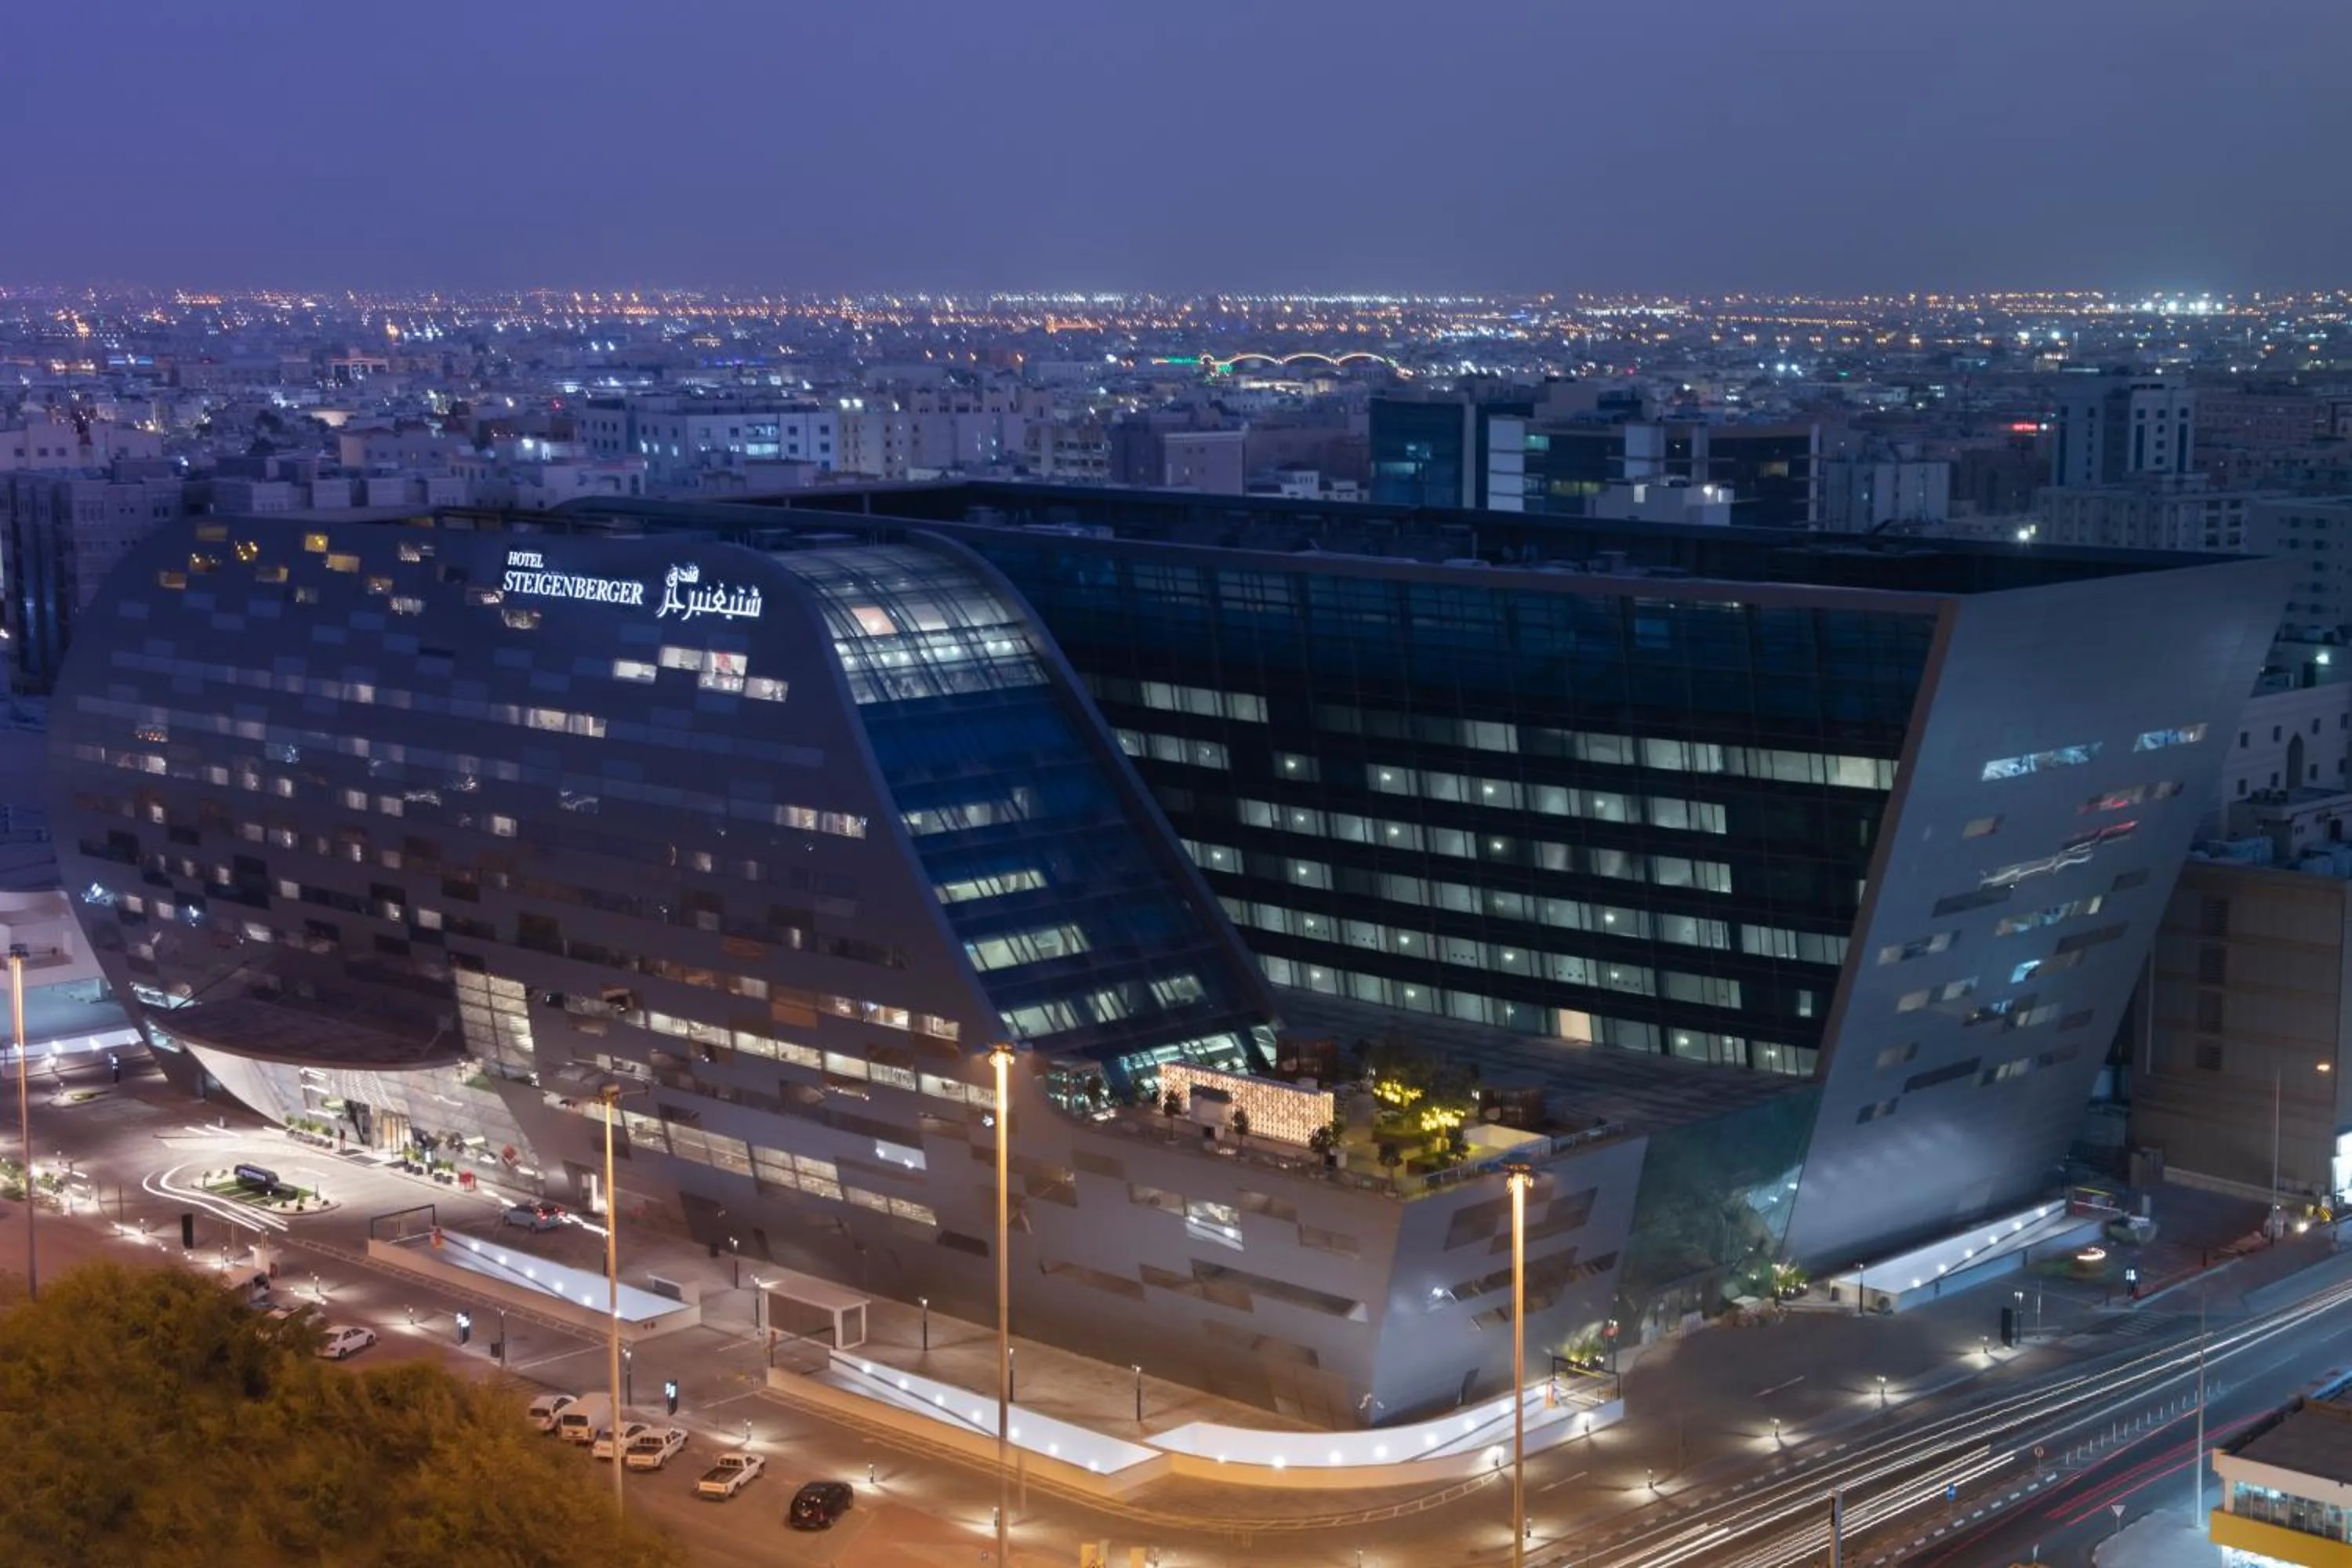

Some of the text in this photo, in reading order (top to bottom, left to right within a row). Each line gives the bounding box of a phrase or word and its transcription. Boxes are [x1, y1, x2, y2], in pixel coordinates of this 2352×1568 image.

[507, 550, 544, 568] HOTEL
[503, 570, 644, 605] STEIGENBERGER
[666, 563, 699, 587] فندق
[655, 582, 762, 621] شتيغنبرجر
